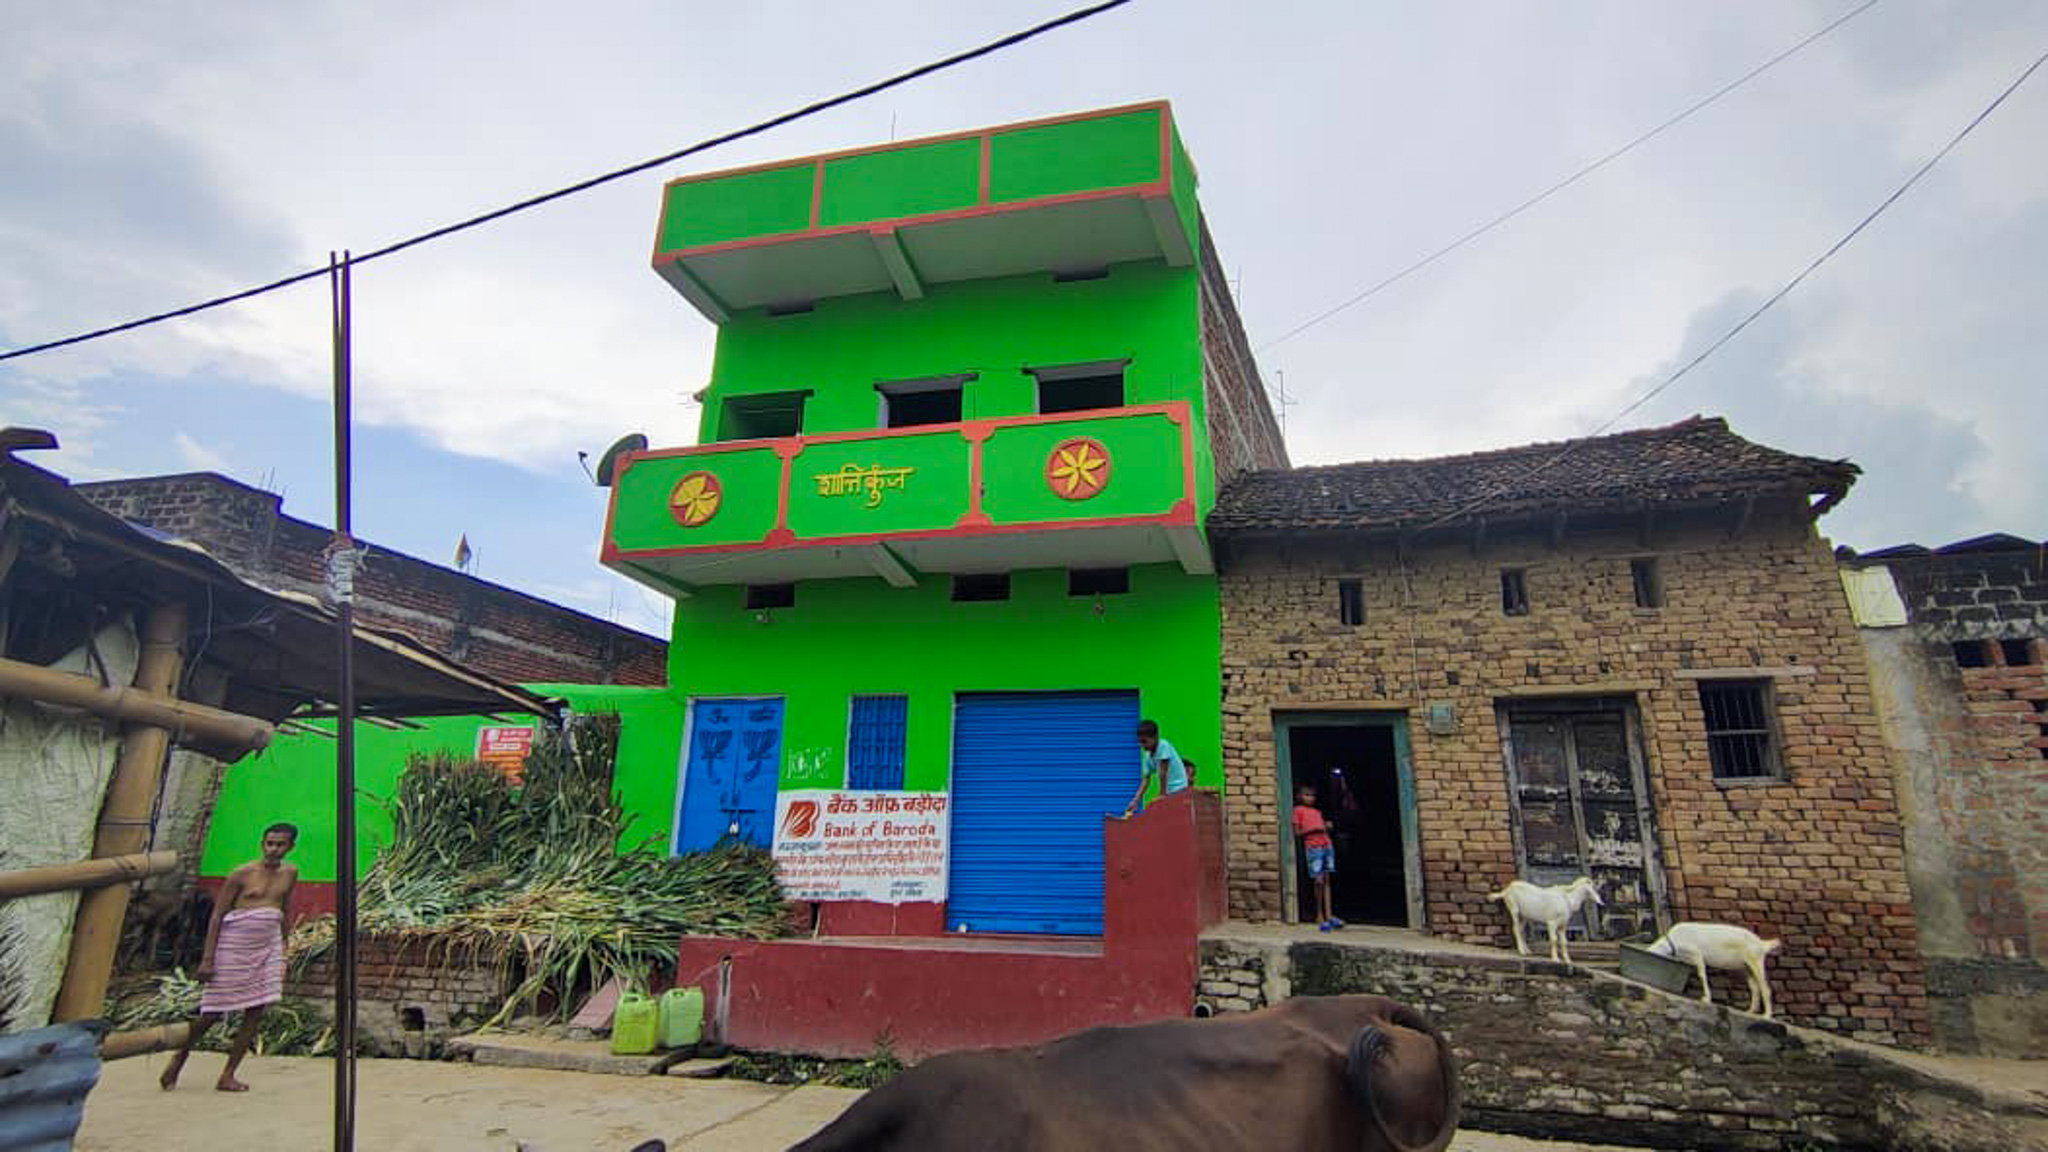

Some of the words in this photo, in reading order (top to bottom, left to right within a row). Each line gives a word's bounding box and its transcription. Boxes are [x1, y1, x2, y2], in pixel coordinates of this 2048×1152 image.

[826, 793, 858, 814] बैंक
[824, 821, 857, 838] Bank
[862, 821, 877, 837] of
[883, 820, 936, 837] Baroda
